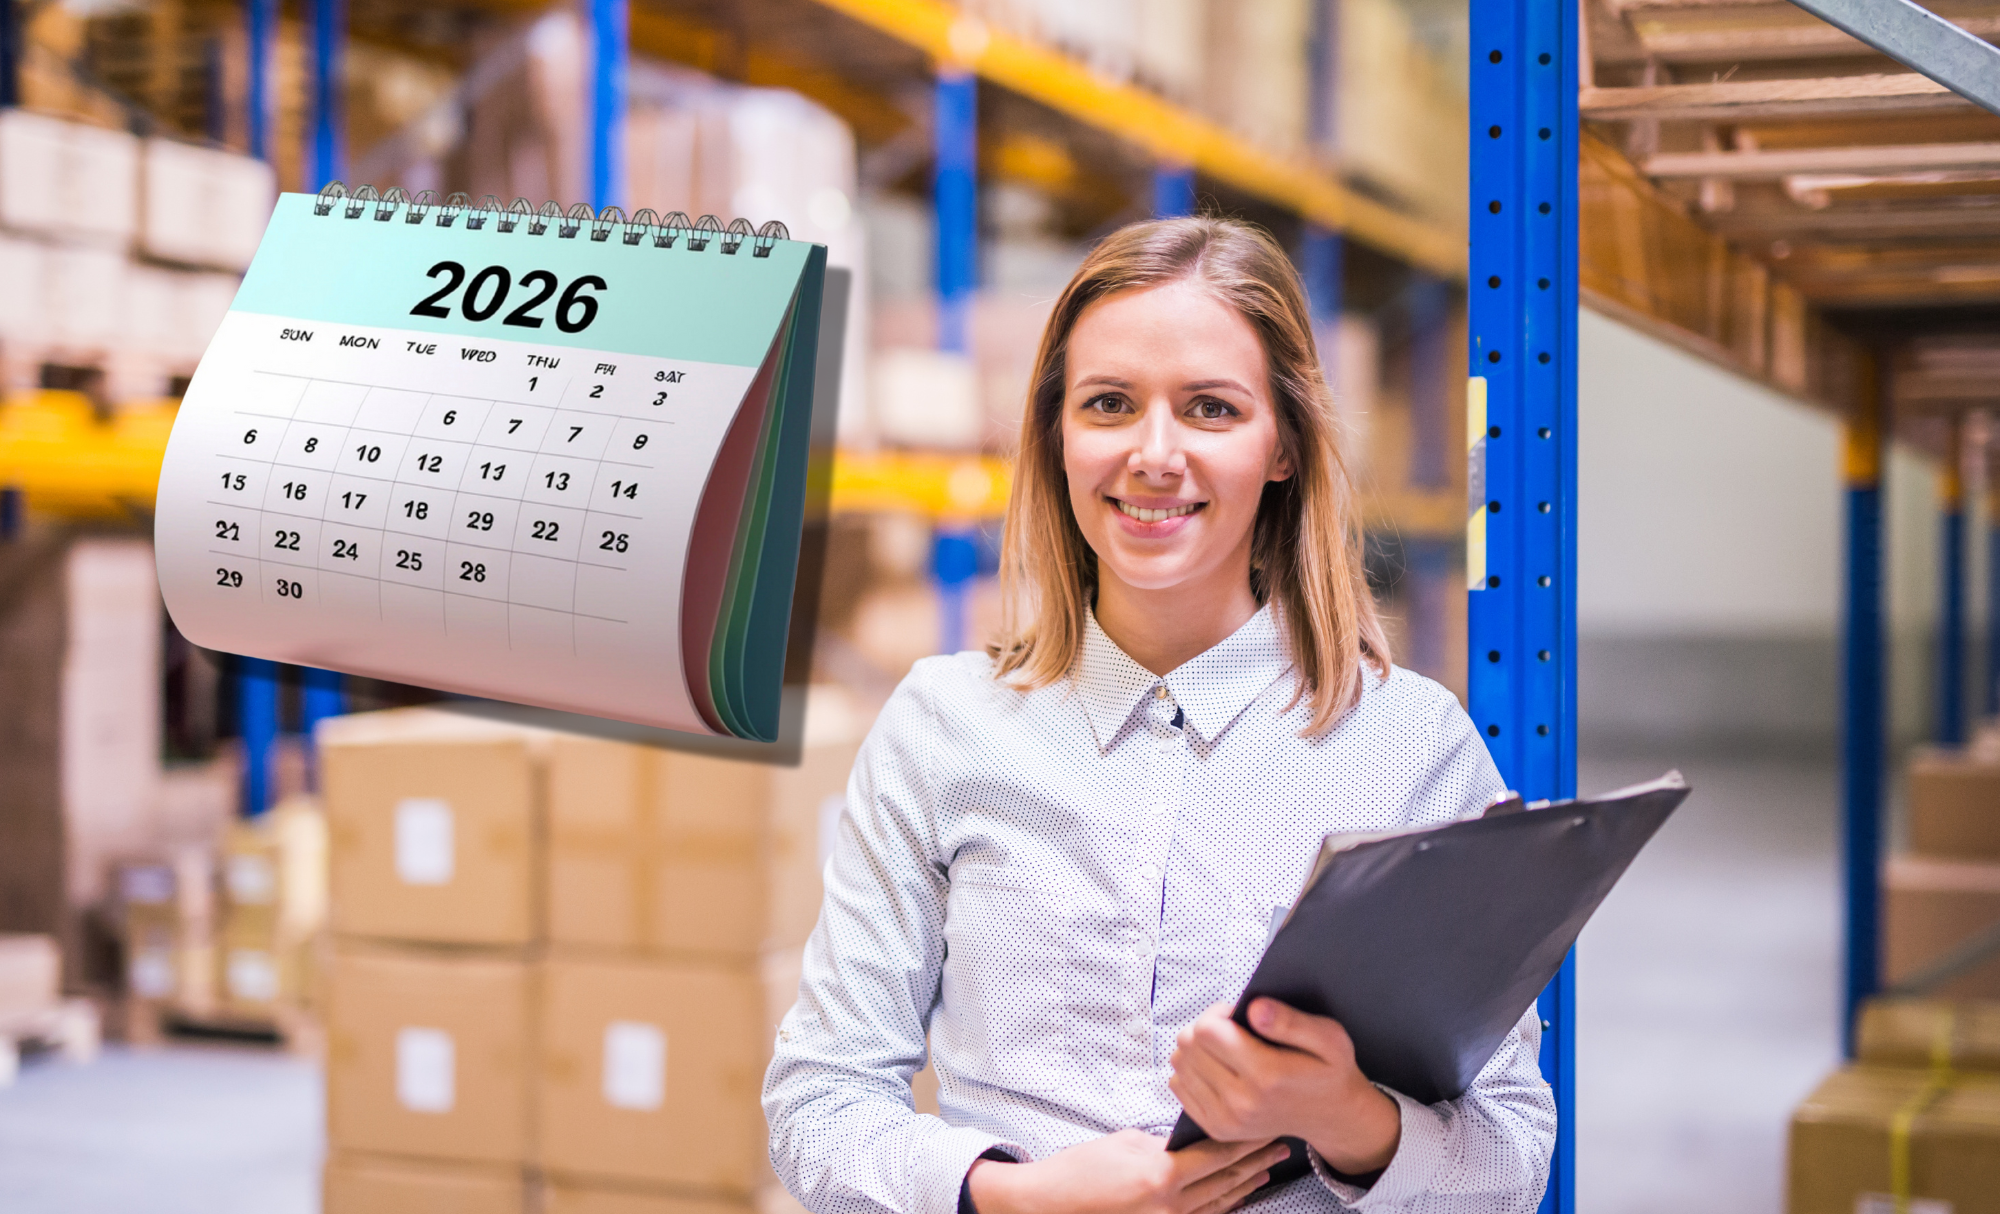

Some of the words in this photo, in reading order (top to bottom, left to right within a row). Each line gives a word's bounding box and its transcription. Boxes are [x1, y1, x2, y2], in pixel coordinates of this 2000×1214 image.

[409, 260, 608, 334] 2026
[280, 328, 314, 342] SUN
[339, 335, 380, 350] MON
[407, 341, 437, 355] TUE
[527, 354, 561, 369] THU
[529, 376, 538, 392] 1
[589, 384, 605, 399] 2
[652, 391, 668, 406] 3
[443, 410, 457, 426] 6
[508, 418, 523, 435] 7
[567, 426, 584, 443] 7
[243, 429, 258, 445] 6
[304, 437, 319, 453] 8
[356, 444, 382, 463] 10
[417, 453, 443, 473] 12
[545, 471, 571, 491] 13
[610, 480, 639, 500] 14
[221, 472, 247, 491] 15
[341, 491, 367, 510] 17
[404, 500, 429, 521] 18
[466, 511, 495, 532] 29
[530, 520, 560, 542] 22
[274, 529, 301, 552] 22
[331, 539, 359, 562] 24
[395, 549, 423, 572] 25
[458, 560, 487, 583] 28
[216, 567, 244, 589] 29
[276, 578, 303, 600] 30
